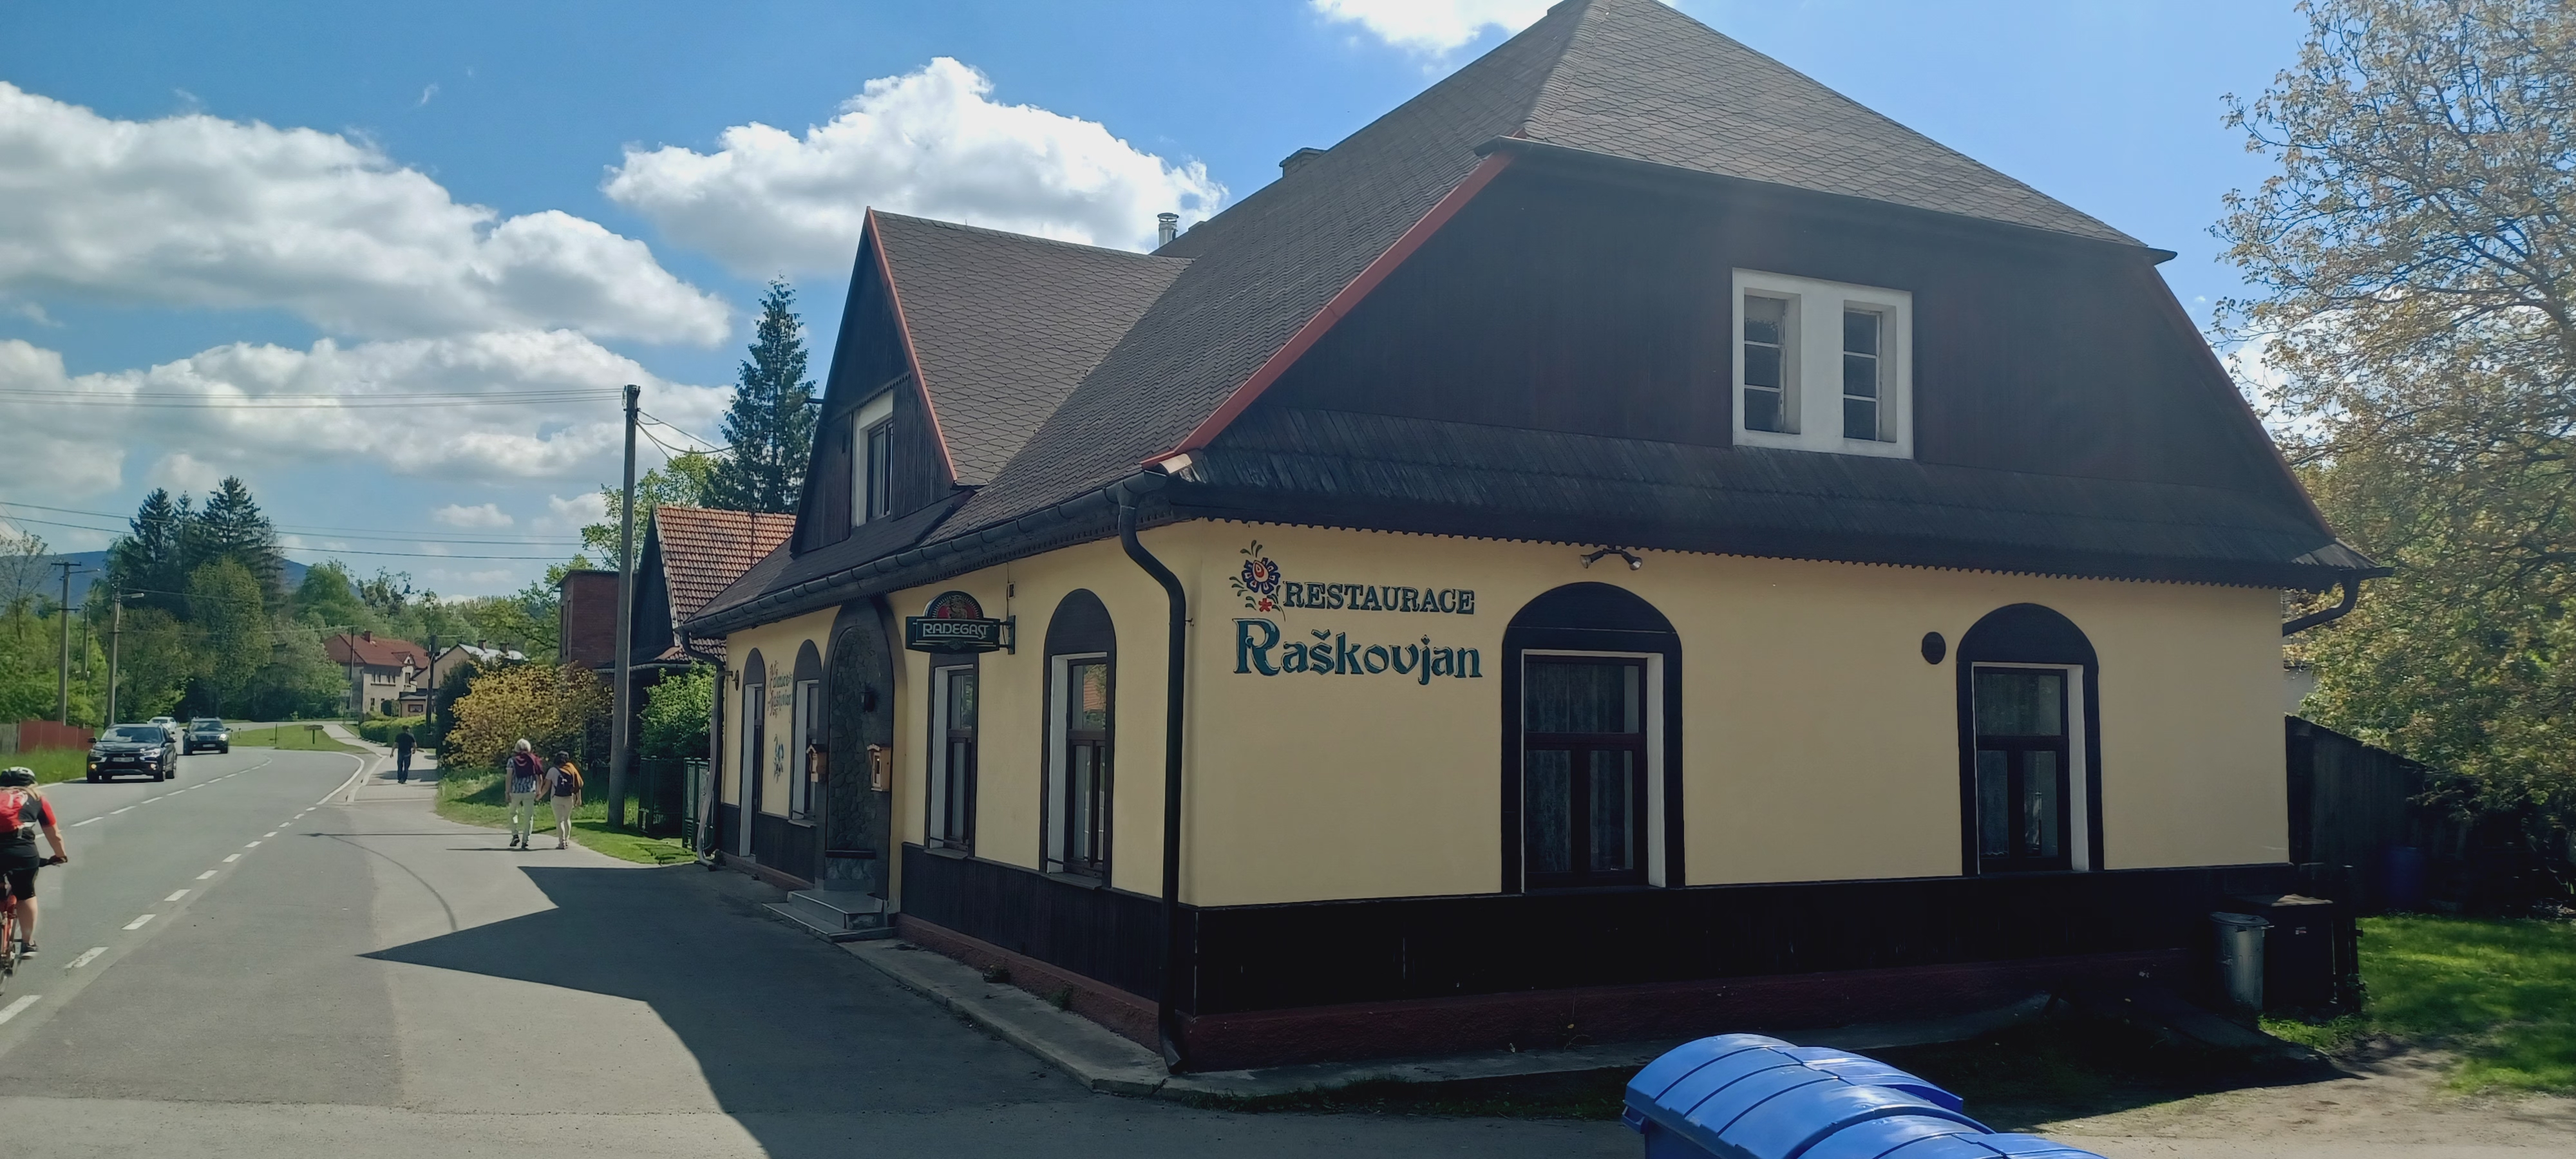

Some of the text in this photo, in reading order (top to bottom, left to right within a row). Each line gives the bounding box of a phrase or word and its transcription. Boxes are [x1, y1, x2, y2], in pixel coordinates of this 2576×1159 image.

[1283, 581, 1475, 614] RESTAURACE
[923, 623, 989, 639] RADEGAST
[1233, 618, 1482, 685] Raškovjan
